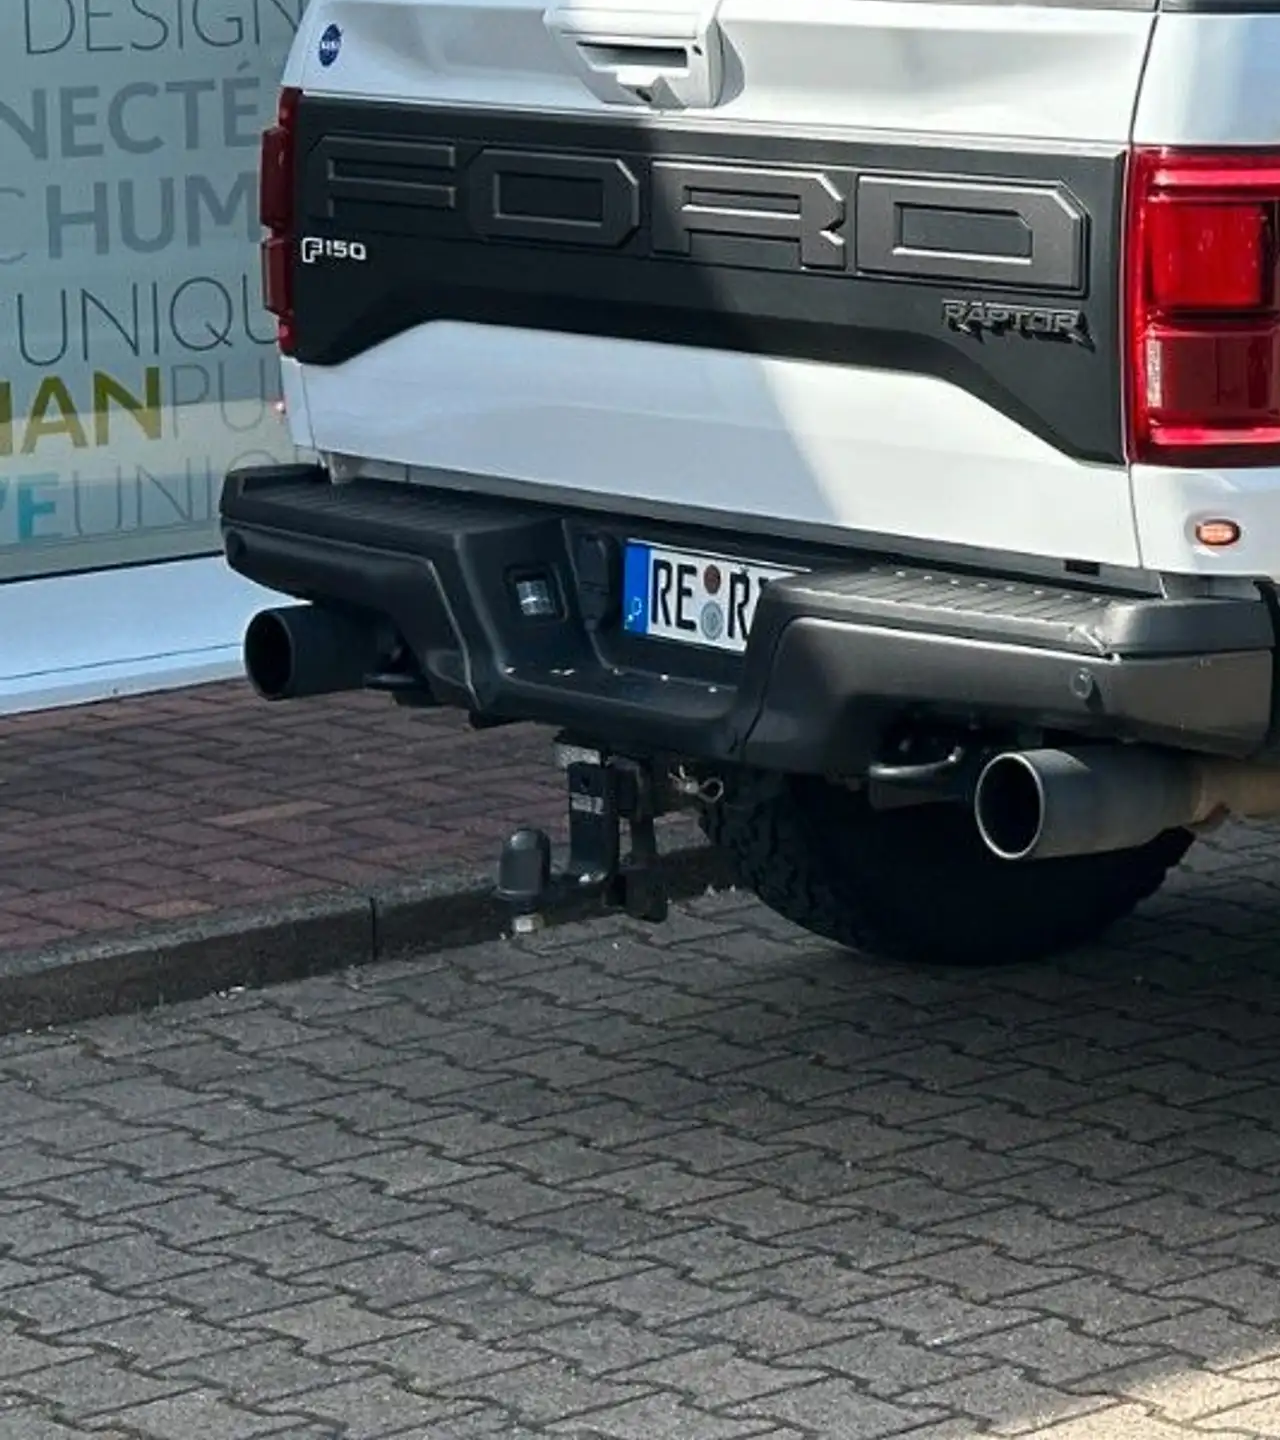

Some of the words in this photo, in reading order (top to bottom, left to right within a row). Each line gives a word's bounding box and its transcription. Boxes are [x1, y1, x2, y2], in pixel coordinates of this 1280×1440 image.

[302, 237, 366, 263] F150
[304, 135, 1088, 298] FORD
[942, 298, 1094, 353] RAPTOR
[652, 559, 697, 631] RE
[727, 569, 769, 641] R
